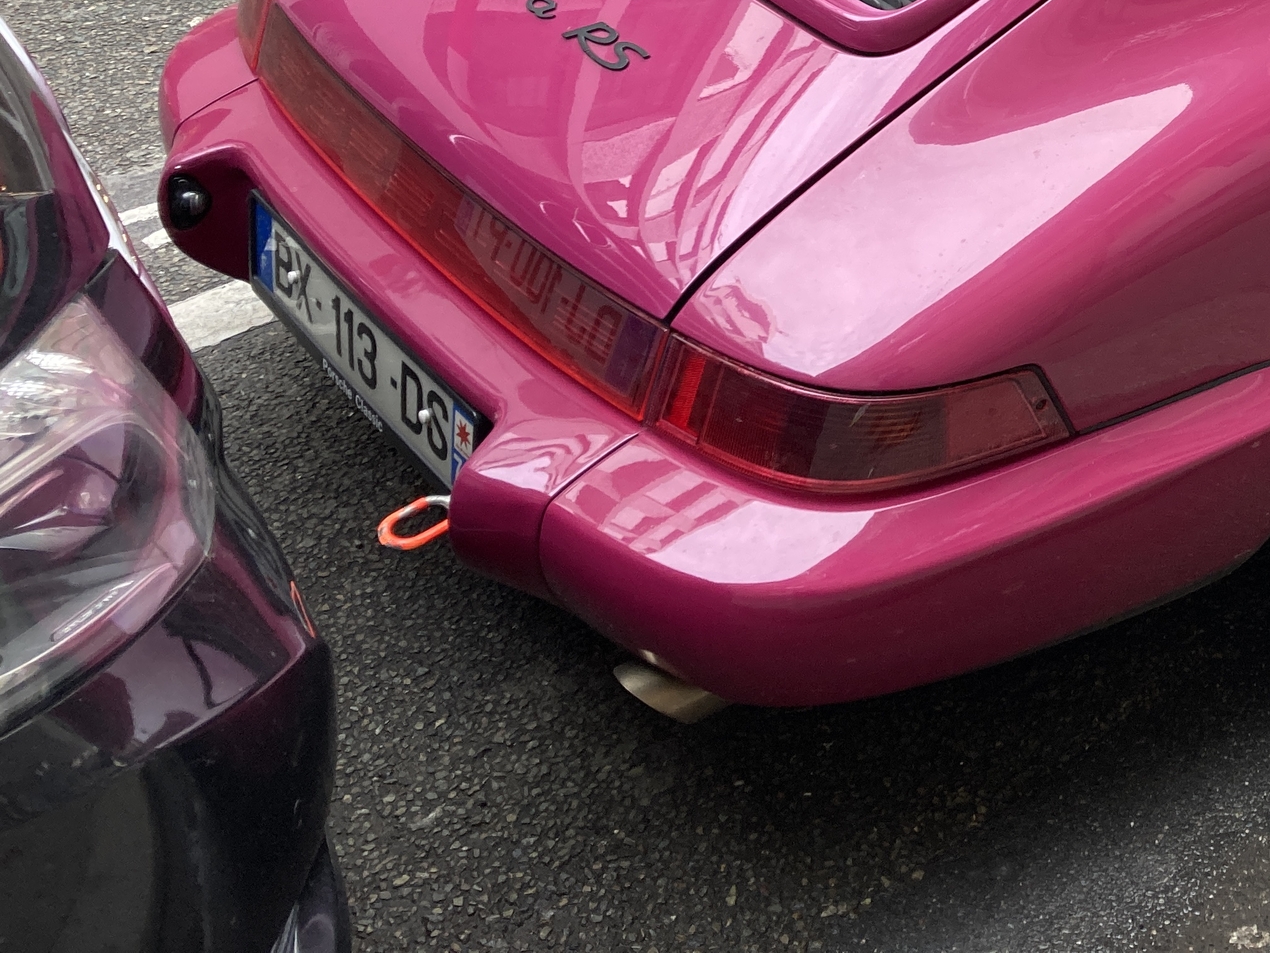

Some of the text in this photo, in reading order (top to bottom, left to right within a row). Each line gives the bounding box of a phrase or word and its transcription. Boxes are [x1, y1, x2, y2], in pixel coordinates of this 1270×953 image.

[562, 21, 650, 71] RS
[322, 357, 384, 433] Porsche Classic
